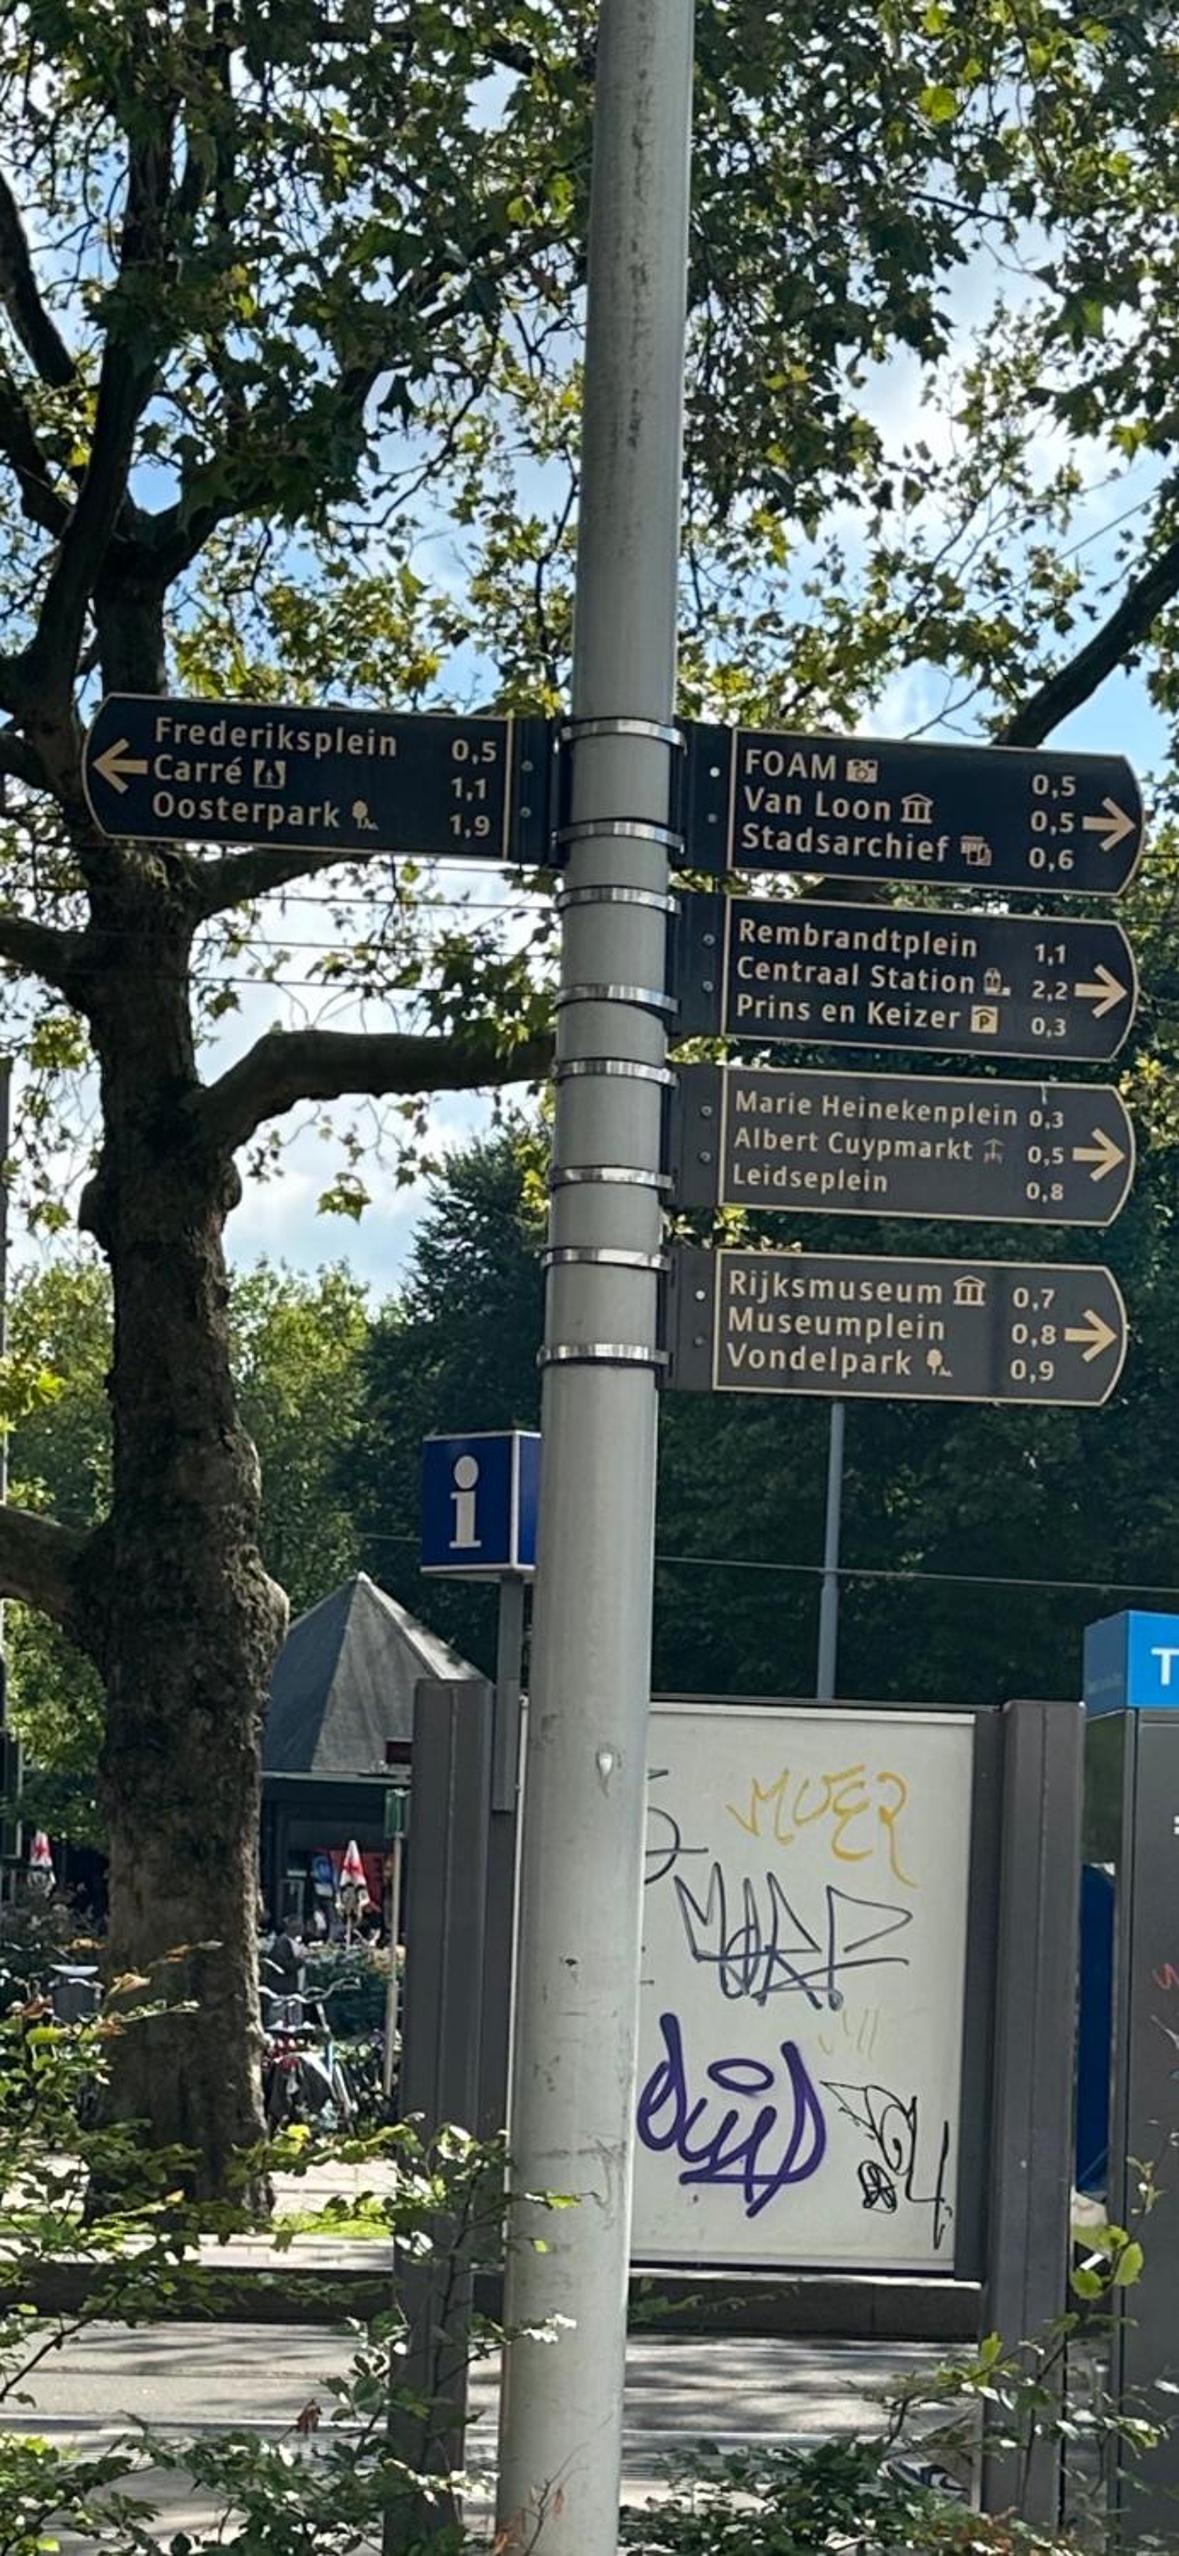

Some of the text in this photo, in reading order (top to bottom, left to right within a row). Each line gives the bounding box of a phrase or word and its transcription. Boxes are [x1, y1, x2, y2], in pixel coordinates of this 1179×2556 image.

[155, 716, 497, 765] Frederiksplein 0,5
[153, 753, 486, 802] Carré 1,1
[745, 748, 1076, 800] FOAM 0,5
[152, 790, 491, 839] Oosterpark 1,9
[743, 785, 1075, 836] Van Loon 0,5
[741, 822, 1075, 873] Stadsarchief 0,6
[738, 918, 1066, 966] Rembrandtplein 1,1
[736, 955, 1068, 1003] Centraal Station 2,2
[736, 993, 811, 1022] Prins
[821, 1003, 855, 1024] en
[867, 1000, 962, 1030] Keizer
[1030, 1016, 1067, 1039] 0,3
[735, 1089, 1064, 1130] Marie Heinekenplein 0,3
[733, 1126, 1064, 1167] Albert Cuypmarkt 0,5
[733, 1162, 1064, 1203] Leidseplein 0,8
[729, 1269, 1055, 1312] Rijksmuseum 0,7
[728, 1305, 1057, 1348] Museumplein 0,8
[726, 1342, 1055, 1385] Vondelpark 0,9
[449, 1455, 482, 1548] i
